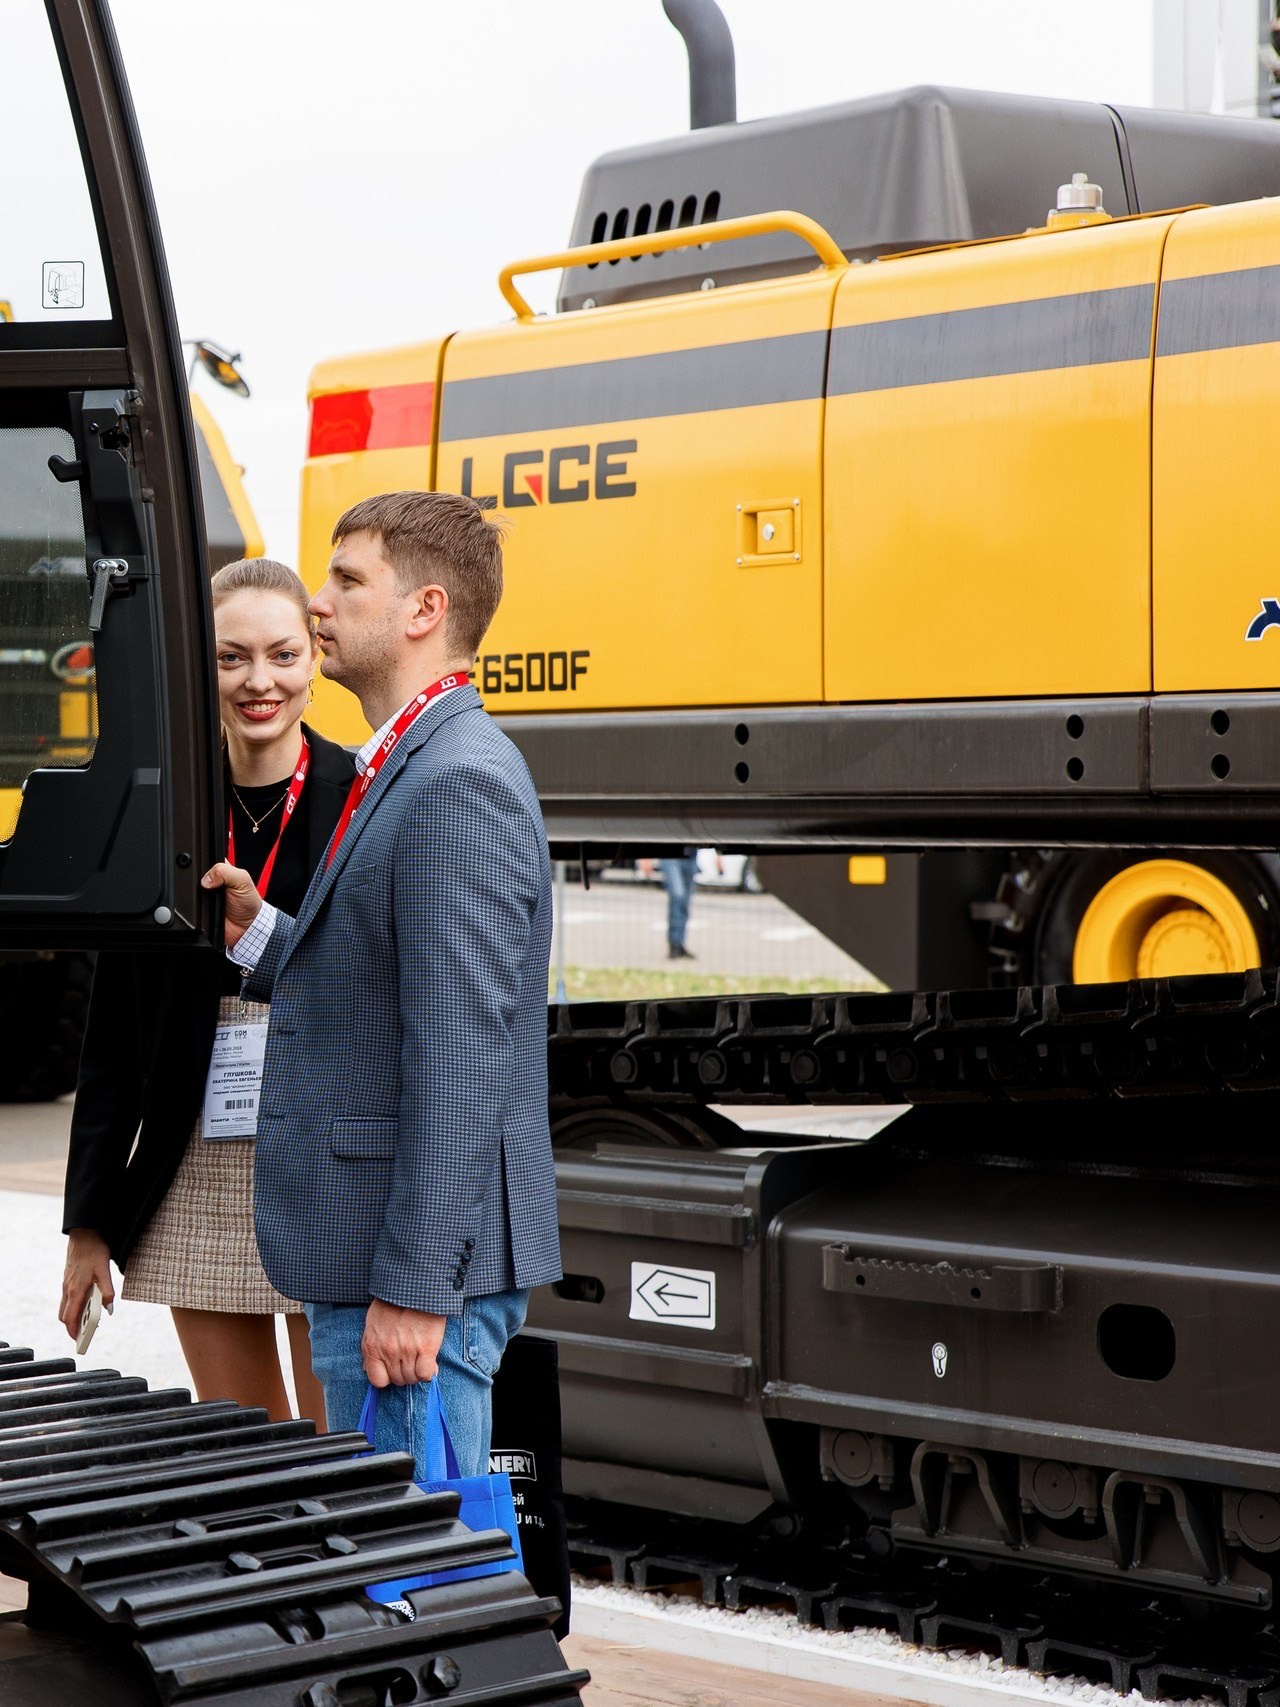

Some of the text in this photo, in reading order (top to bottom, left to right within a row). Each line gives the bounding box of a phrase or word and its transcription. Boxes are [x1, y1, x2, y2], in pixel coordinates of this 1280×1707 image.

[461, 439, 637, 509] LGCE
[223, 1070, 257, 1078] ГЛУШКОВА
[525, 1515, 533, 1525] и
